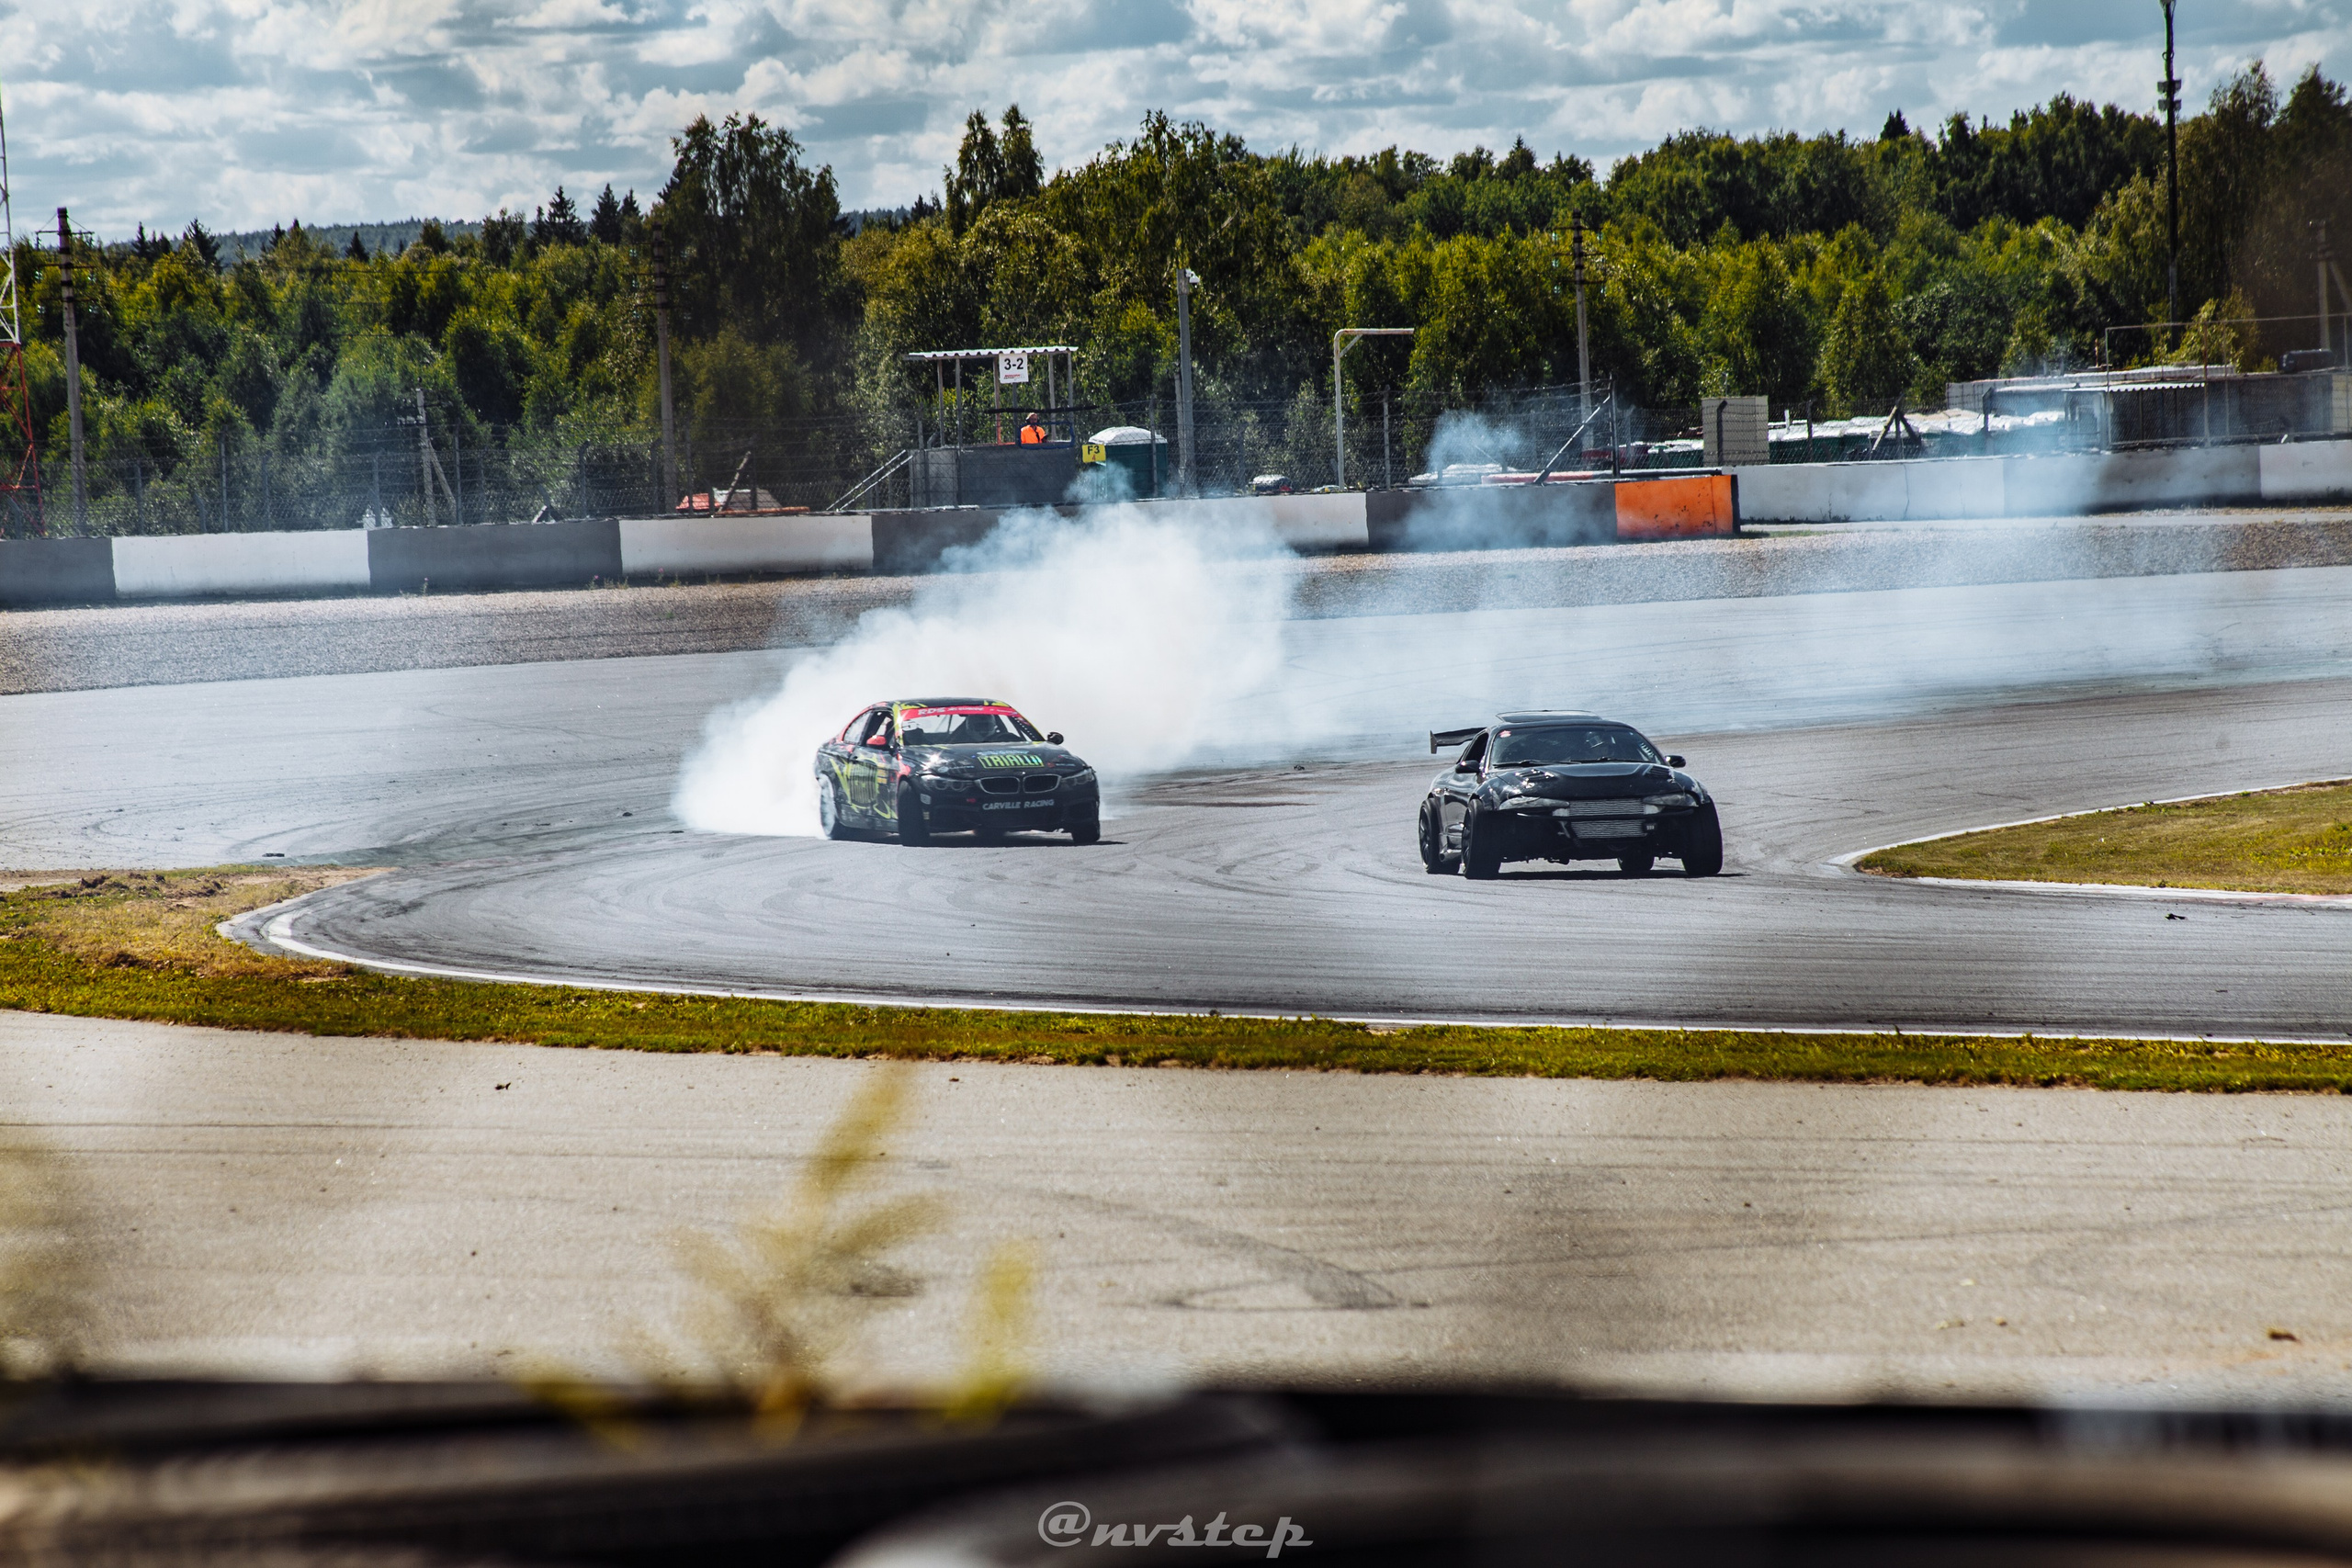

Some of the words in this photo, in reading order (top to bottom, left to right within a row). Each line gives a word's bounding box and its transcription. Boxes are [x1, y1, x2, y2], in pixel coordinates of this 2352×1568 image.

[1004, 358, 1023, 370] 3-2
[1087, 445, 1101, 455] F3
[918, 706, 946, 716] RDS
[980, 754, 1043, 767] TRIALLI
[983, 802, 1021, 810] CARVILLE
[1024, 799, 1055, 808] RACING
